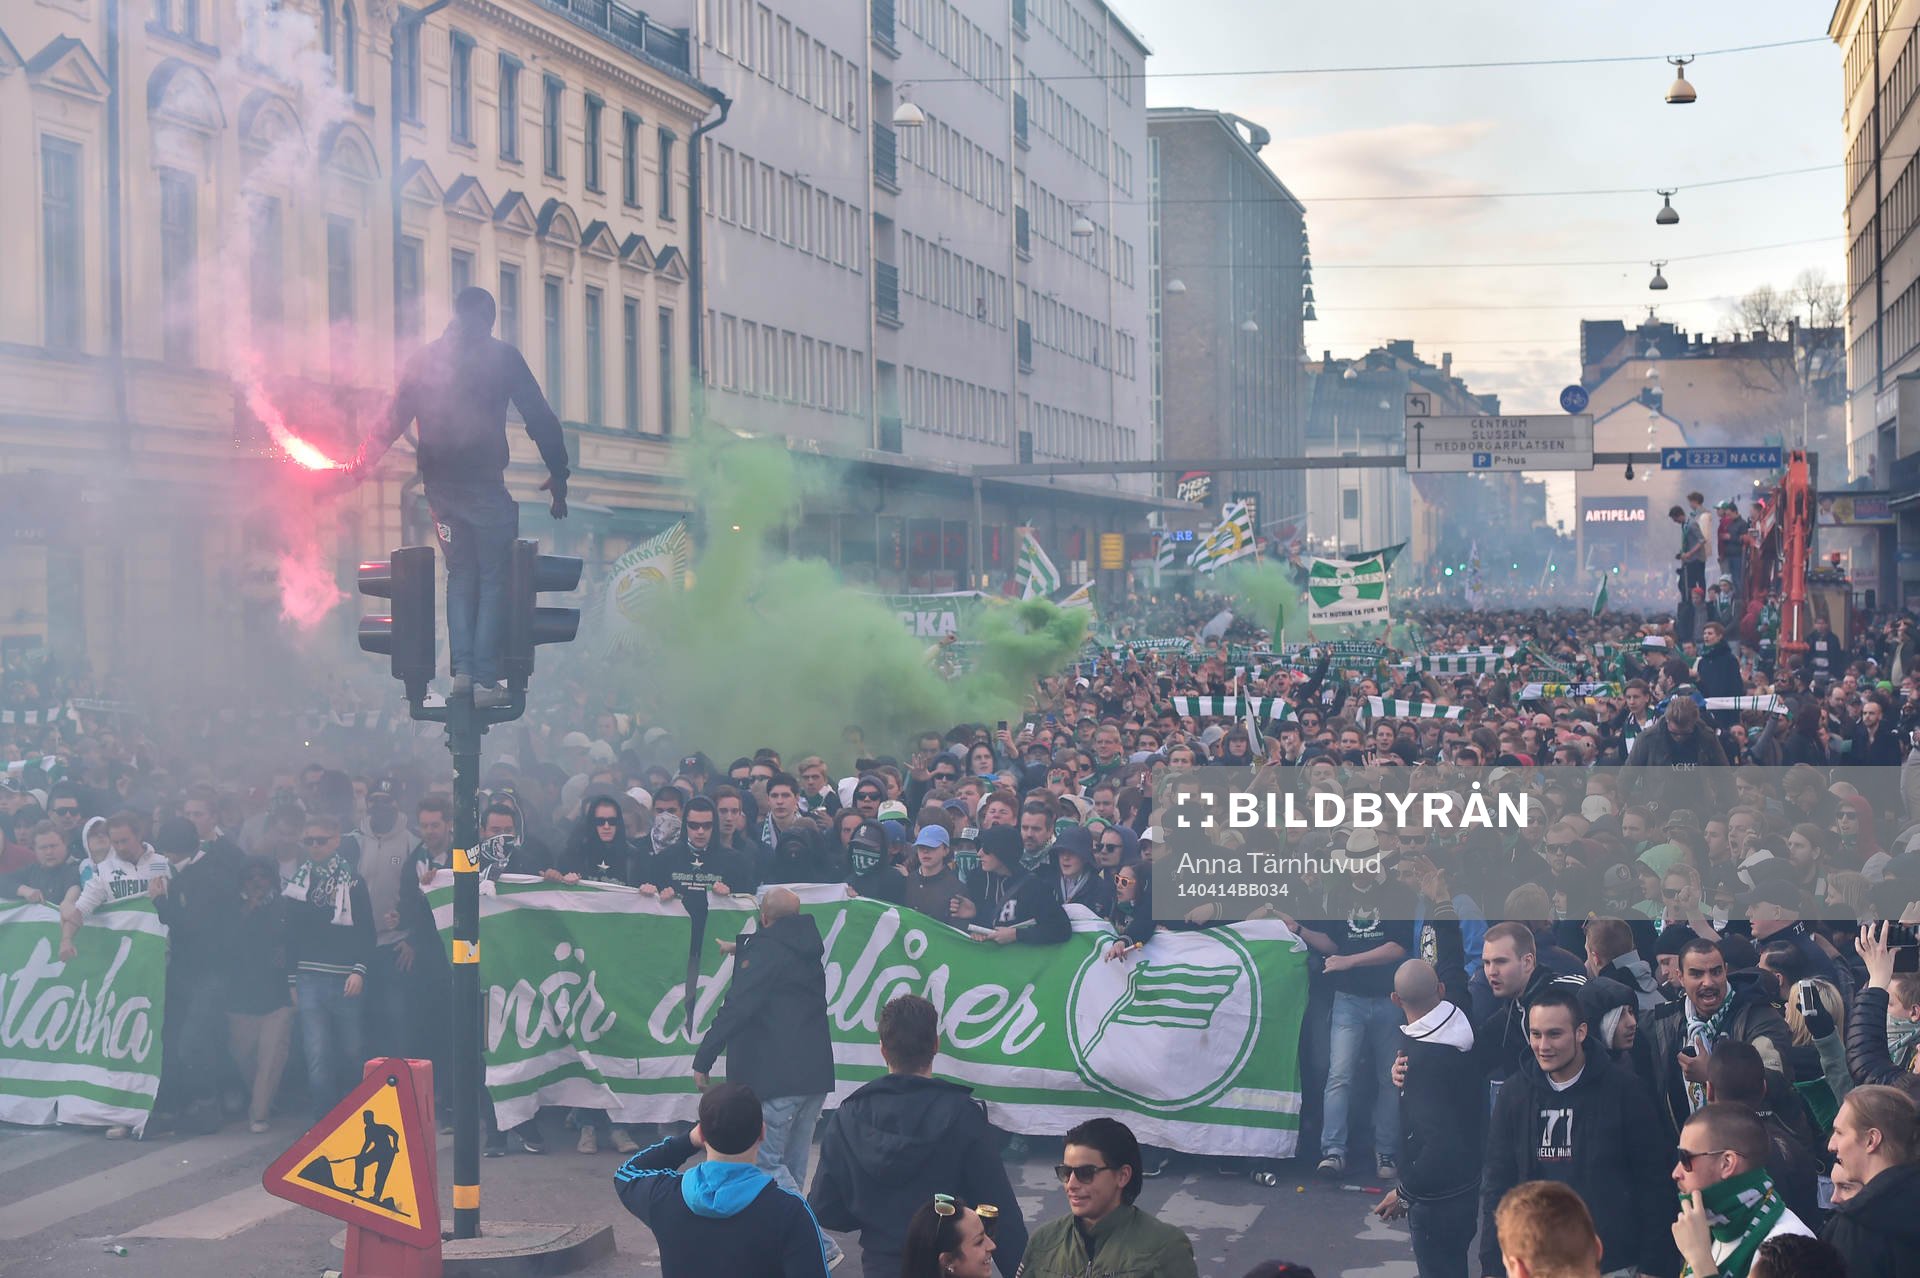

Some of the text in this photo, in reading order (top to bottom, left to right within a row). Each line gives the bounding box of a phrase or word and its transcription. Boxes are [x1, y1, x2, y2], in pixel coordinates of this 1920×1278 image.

[1471, 419, 1527, 428] CENTRUM
[1472, 431, 1527, 440] SLUSSEN
[1434, 440, 1565, 451] MEDBORGARPLATSEN
[1494, 455, 1527, 465] P-hus
[1730, 453, 1776, 463] NACKA
[1585, 509, 1645, 522] ARTIPELAG
[0, 936, 153, 1064] tarka
[488, 942, 616, 1053] när
